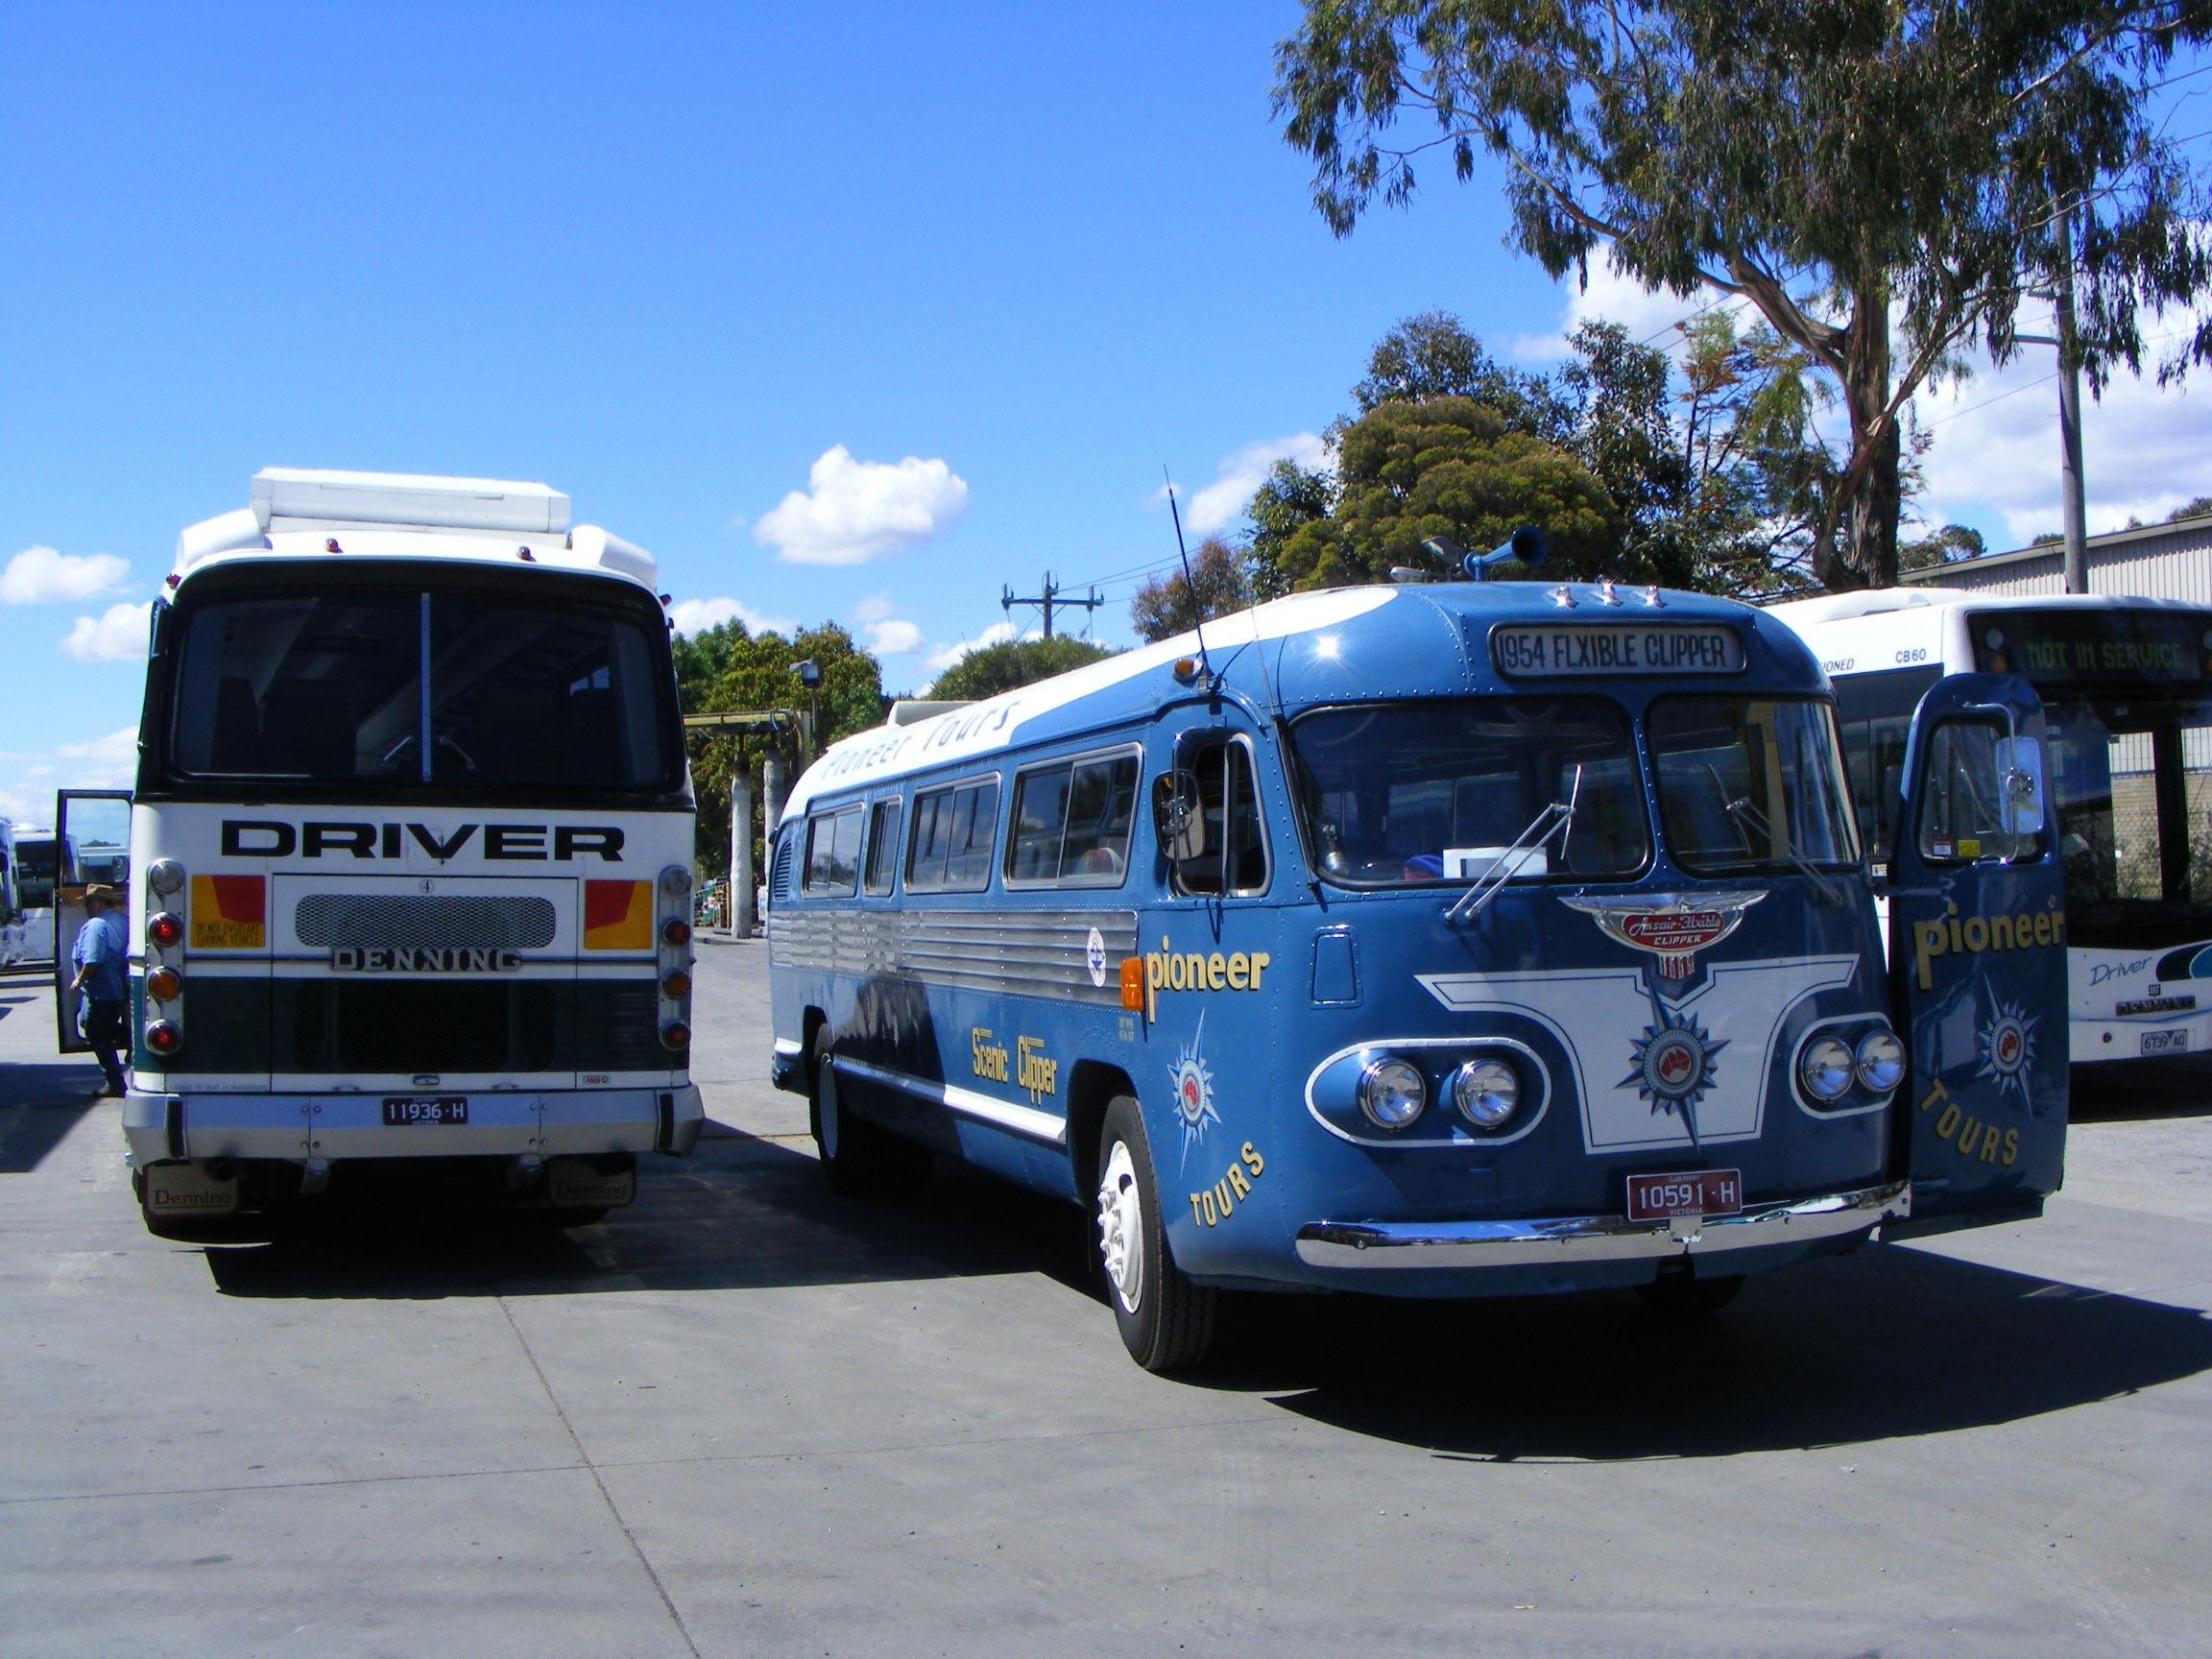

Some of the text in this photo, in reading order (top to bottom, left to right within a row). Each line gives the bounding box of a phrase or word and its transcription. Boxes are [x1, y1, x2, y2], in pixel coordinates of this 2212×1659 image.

[1497, 634, 1727, 668] 1954 FLXIBLE CLIPPER
[1820, 658, 1855, 673] IONED
[1895, 648, 1927, 663] CB60
[2027, 640, 2185, 669] NOT IN SERVICE
[922, 700, 1021, 752] Tours
[221, 819, 625, 862] DRIVER
[207, 922, 221, 934] NOT
[223, 923, 259, 934] OVERTAKE
[1652, 934, 1702, 946] CLIPPER
[331, 947, 522, 972] DENNING
[1913, 902, 2064, 990] pioneer
[1145, 934, 1270, 1024] pioneer
[2089, 956, 2153, 987] Driver
[2144, 1036, 2169, 1050] 6739
[972, 1026, 1057, 1106] Scenic Clipper
[1920, 1077, 2018, 1166] TOURS
[155, 1190, 230, 1206] Denning
[1190, 1141, 1264, 1227] TOURS
[1669, 1207, 1704, 1216] VICTORIA
